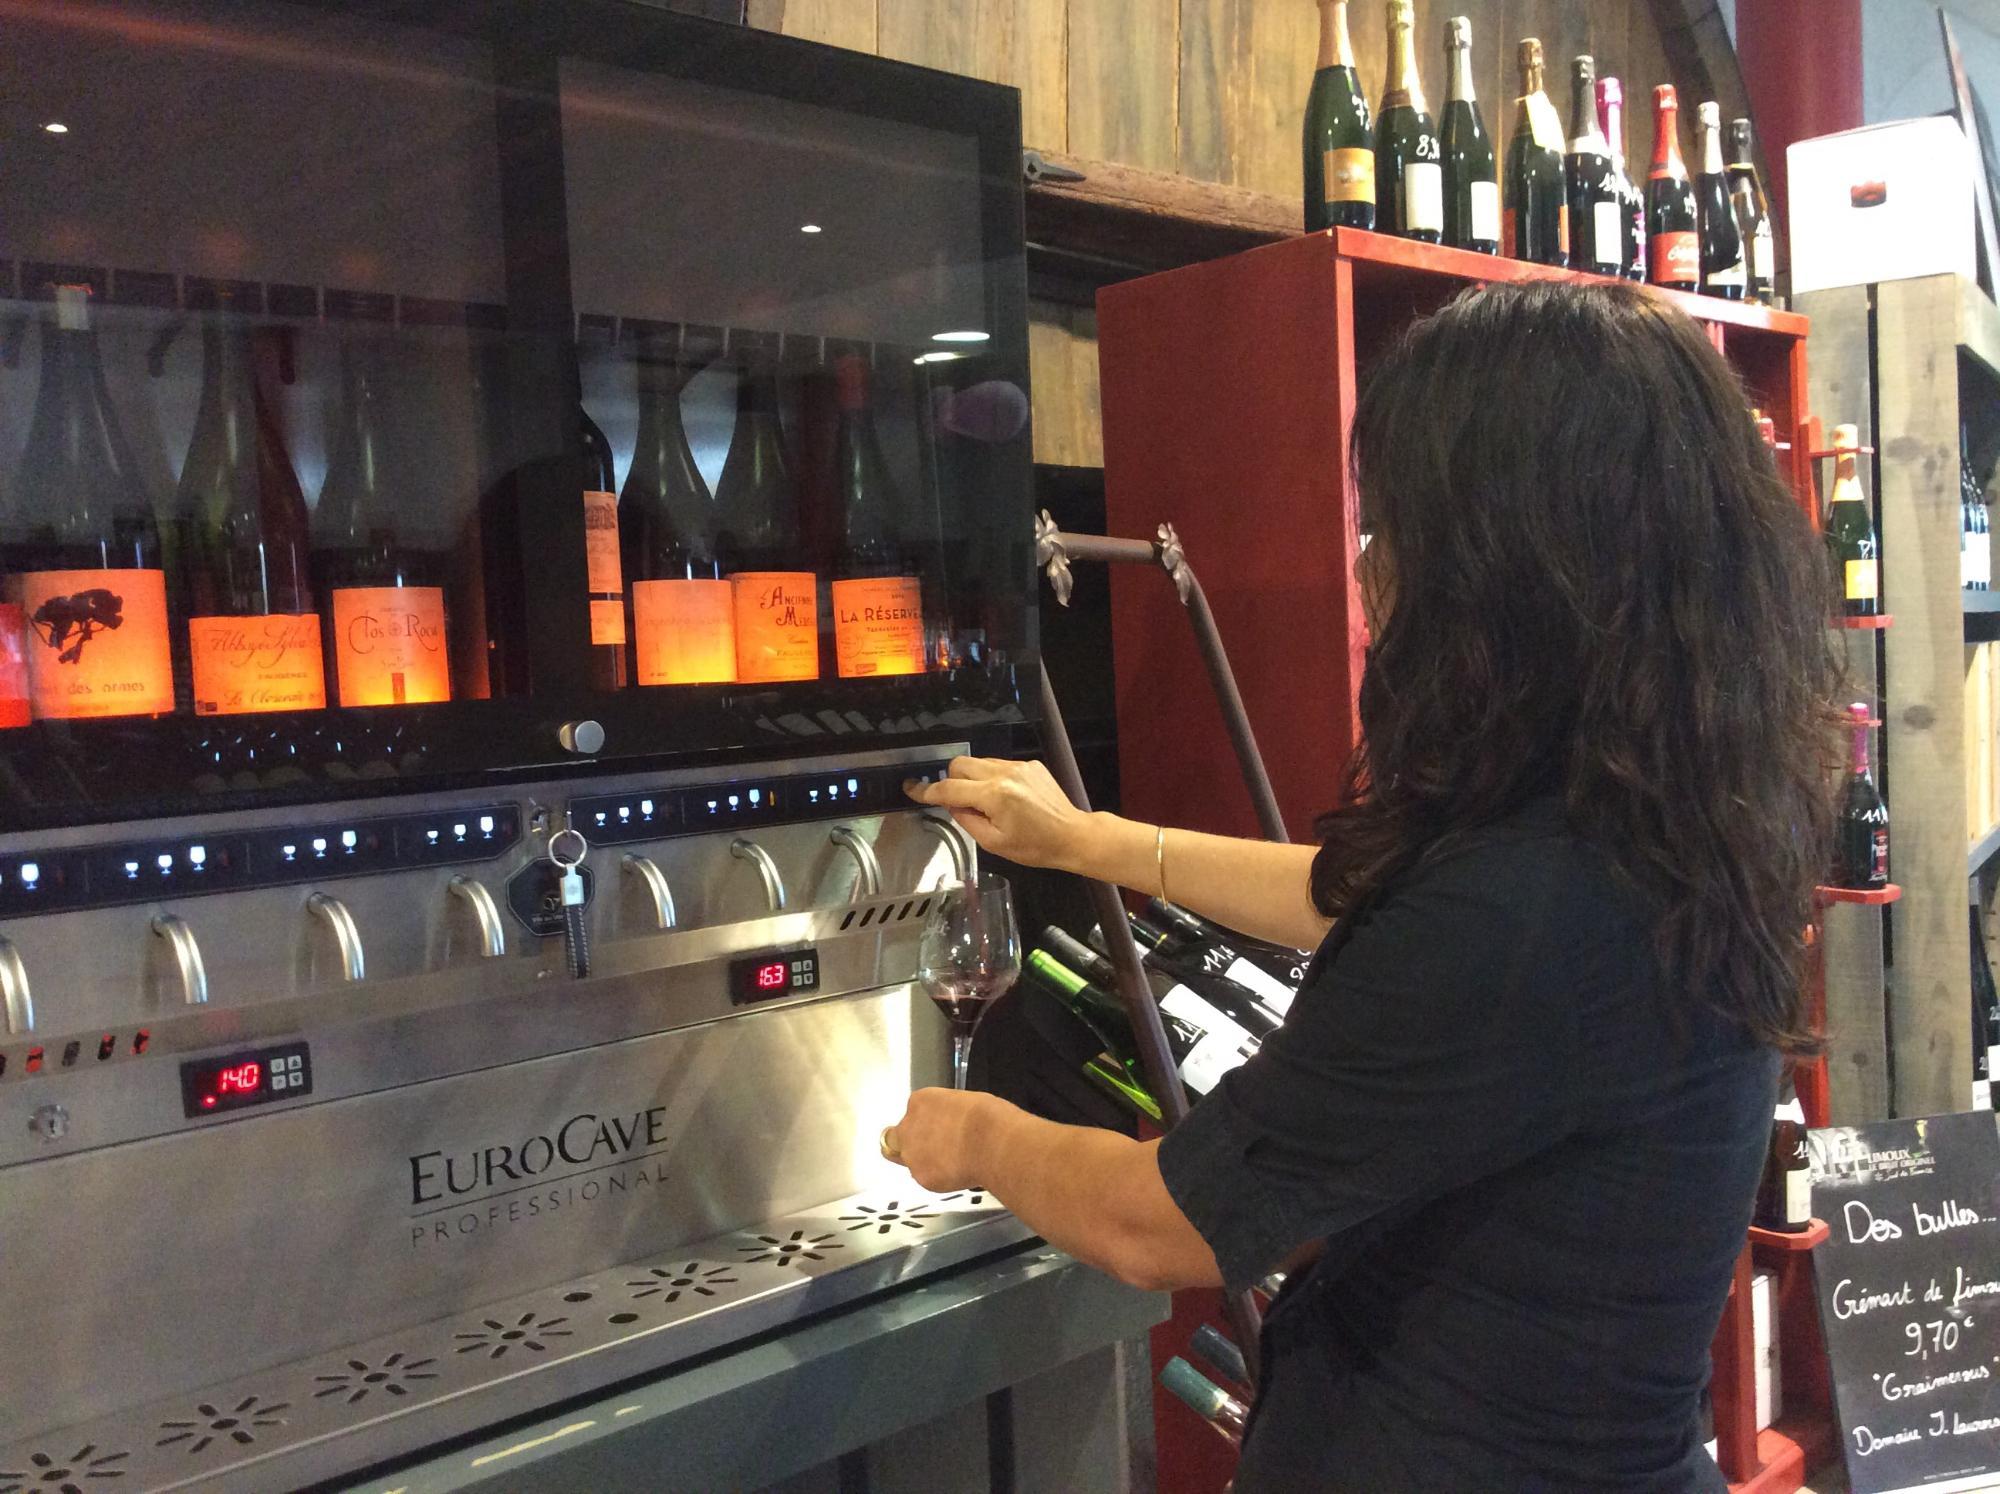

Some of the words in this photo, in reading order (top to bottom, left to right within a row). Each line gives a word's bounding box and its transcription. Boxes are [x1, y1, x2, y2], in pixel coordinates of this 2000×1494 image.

[840, 609, 858, 623] LA
[412, 1164, 669, 1248] PROFESSIONAL
[1843, 1200, 1903, 1244] Des
[1924, 1278, 1944, 1302] de
[1852, 1425, 1921, 1456] Domaine
